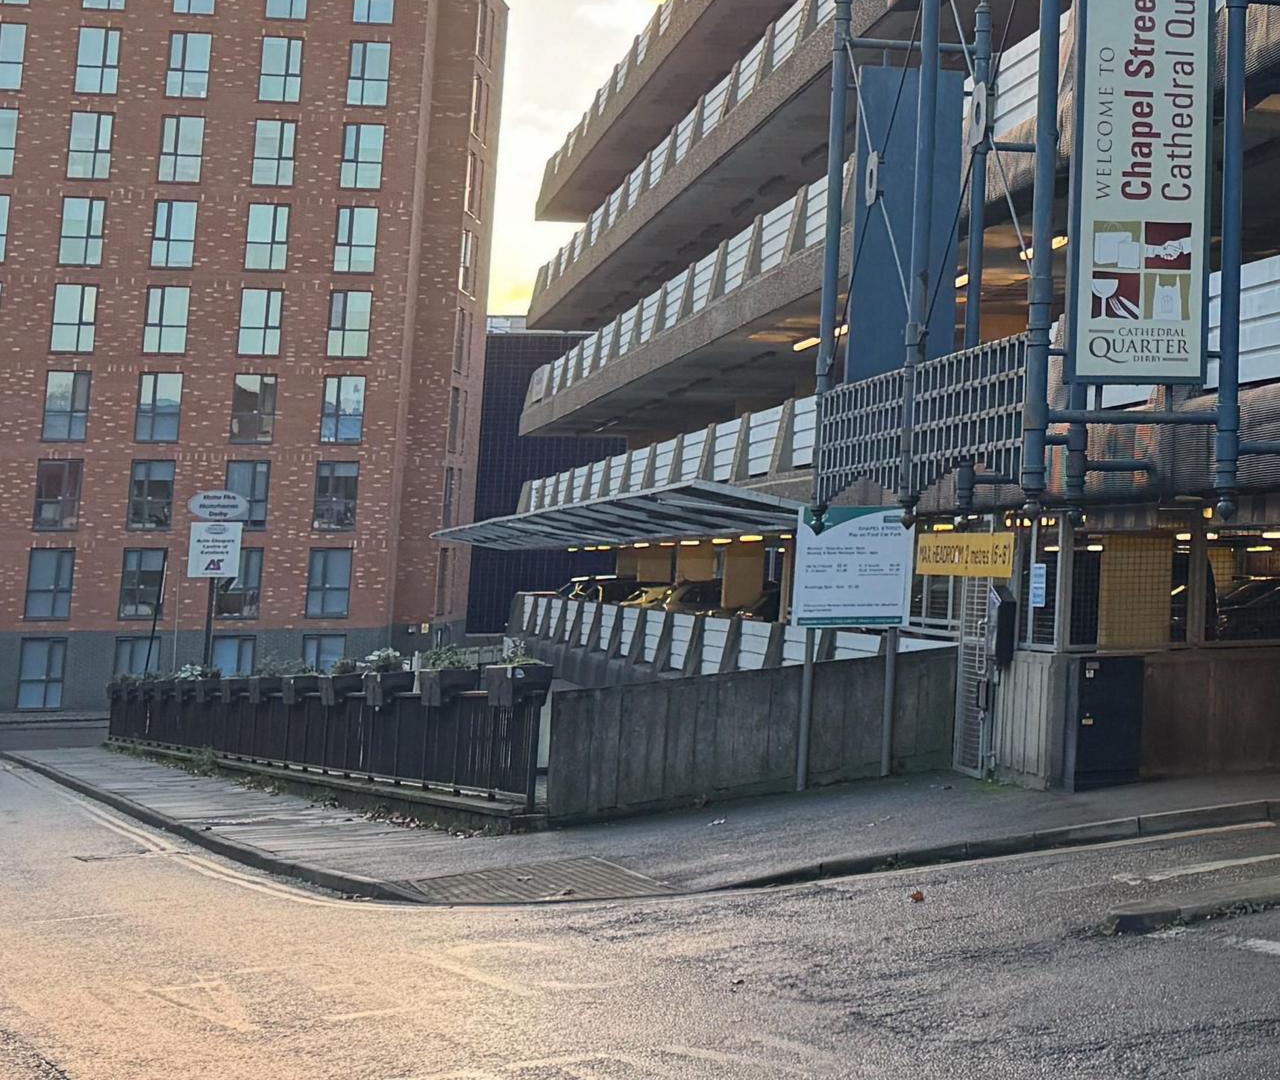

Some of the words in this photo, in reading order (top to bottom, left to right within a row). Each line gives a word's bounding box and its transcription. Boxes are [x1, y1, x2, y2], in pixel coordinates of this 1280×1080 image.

[1099, 46, 1116, 77] TO
[1096, 85, 1114, 200] WELCOME
[1120, 90, 1161, 201] Chapel
[1161, 51, 1195, 201] Cathedral
[1088, 336, 1190, 363] QUARTER
[1118, 327, 1186, 337] CATHEDRAL
